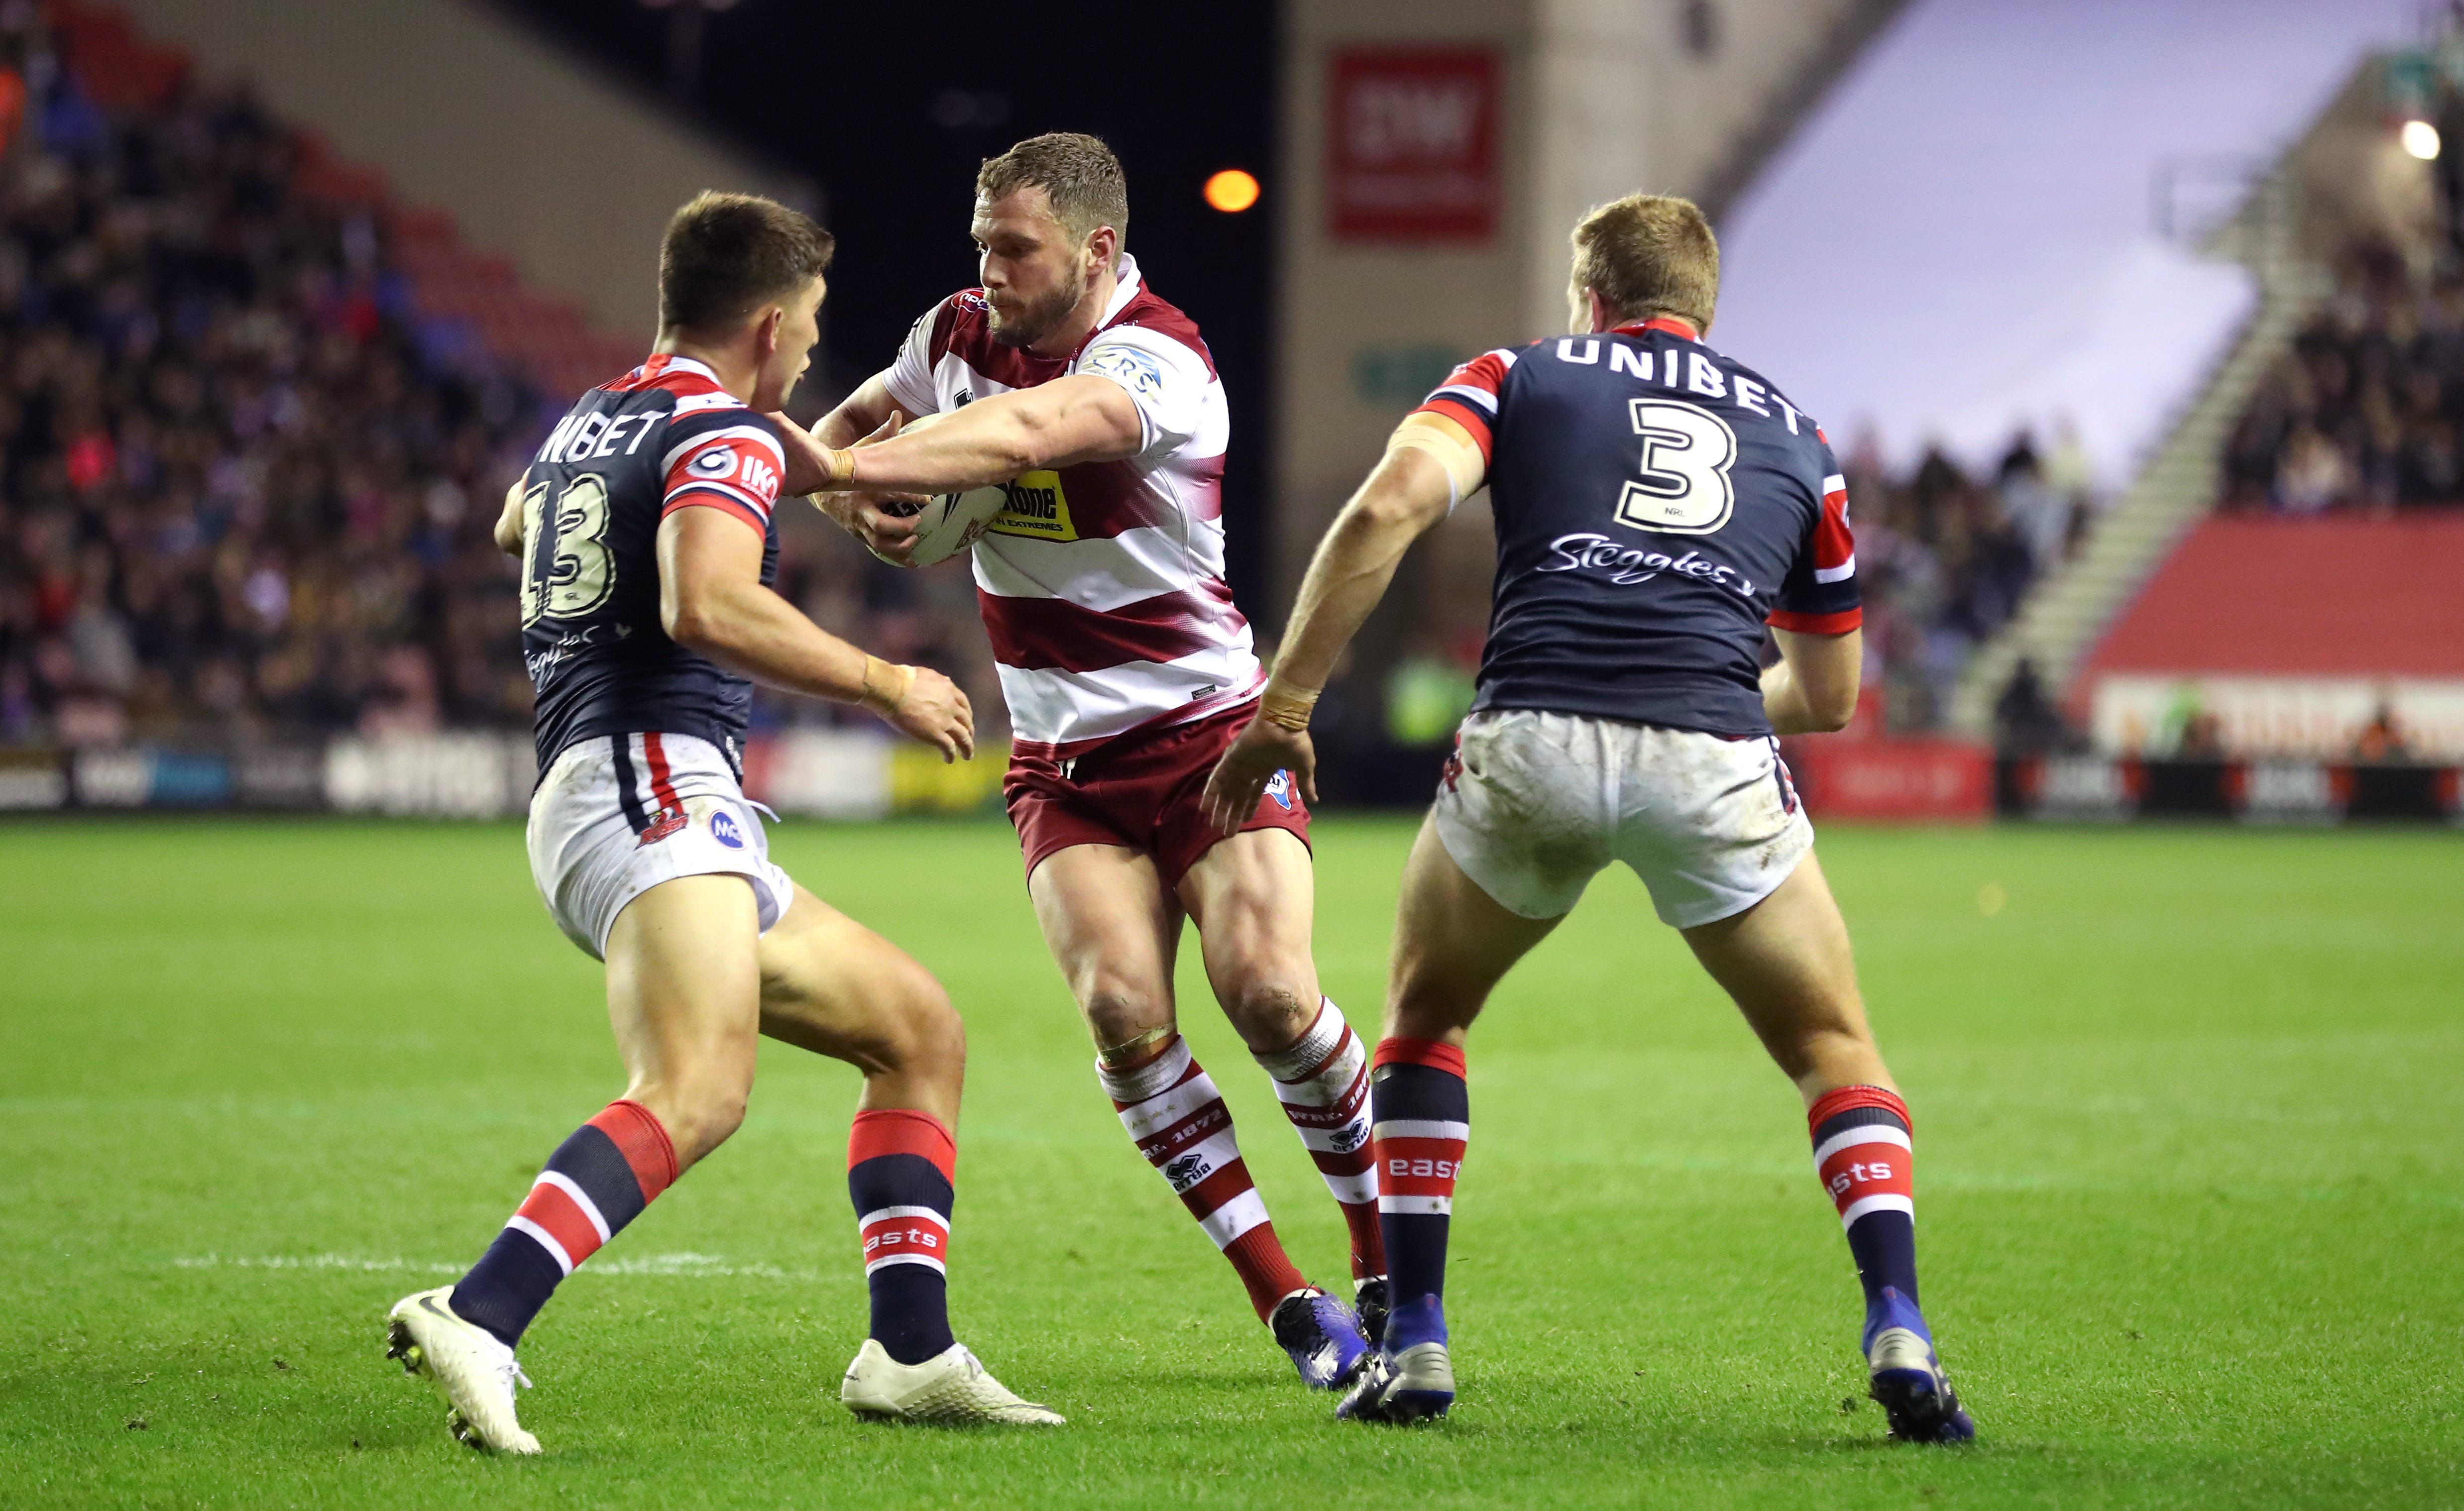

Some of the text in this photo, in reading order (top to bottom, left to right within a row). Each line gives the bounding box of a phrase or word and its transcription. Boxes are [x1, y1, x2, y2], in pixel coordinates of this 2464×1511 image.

[1557, 339, 1804, 436] UNIBET
[1613, 398, 1738, 536] 3
[1007, 519, 1064, 532] EXTREMES
[520, 473, 616, 631] 13
[1535, 533, 1736, 585] Steggles
[1389, 1158, 1462, 1181] east
[864, 1228, 938, 1254] asts
